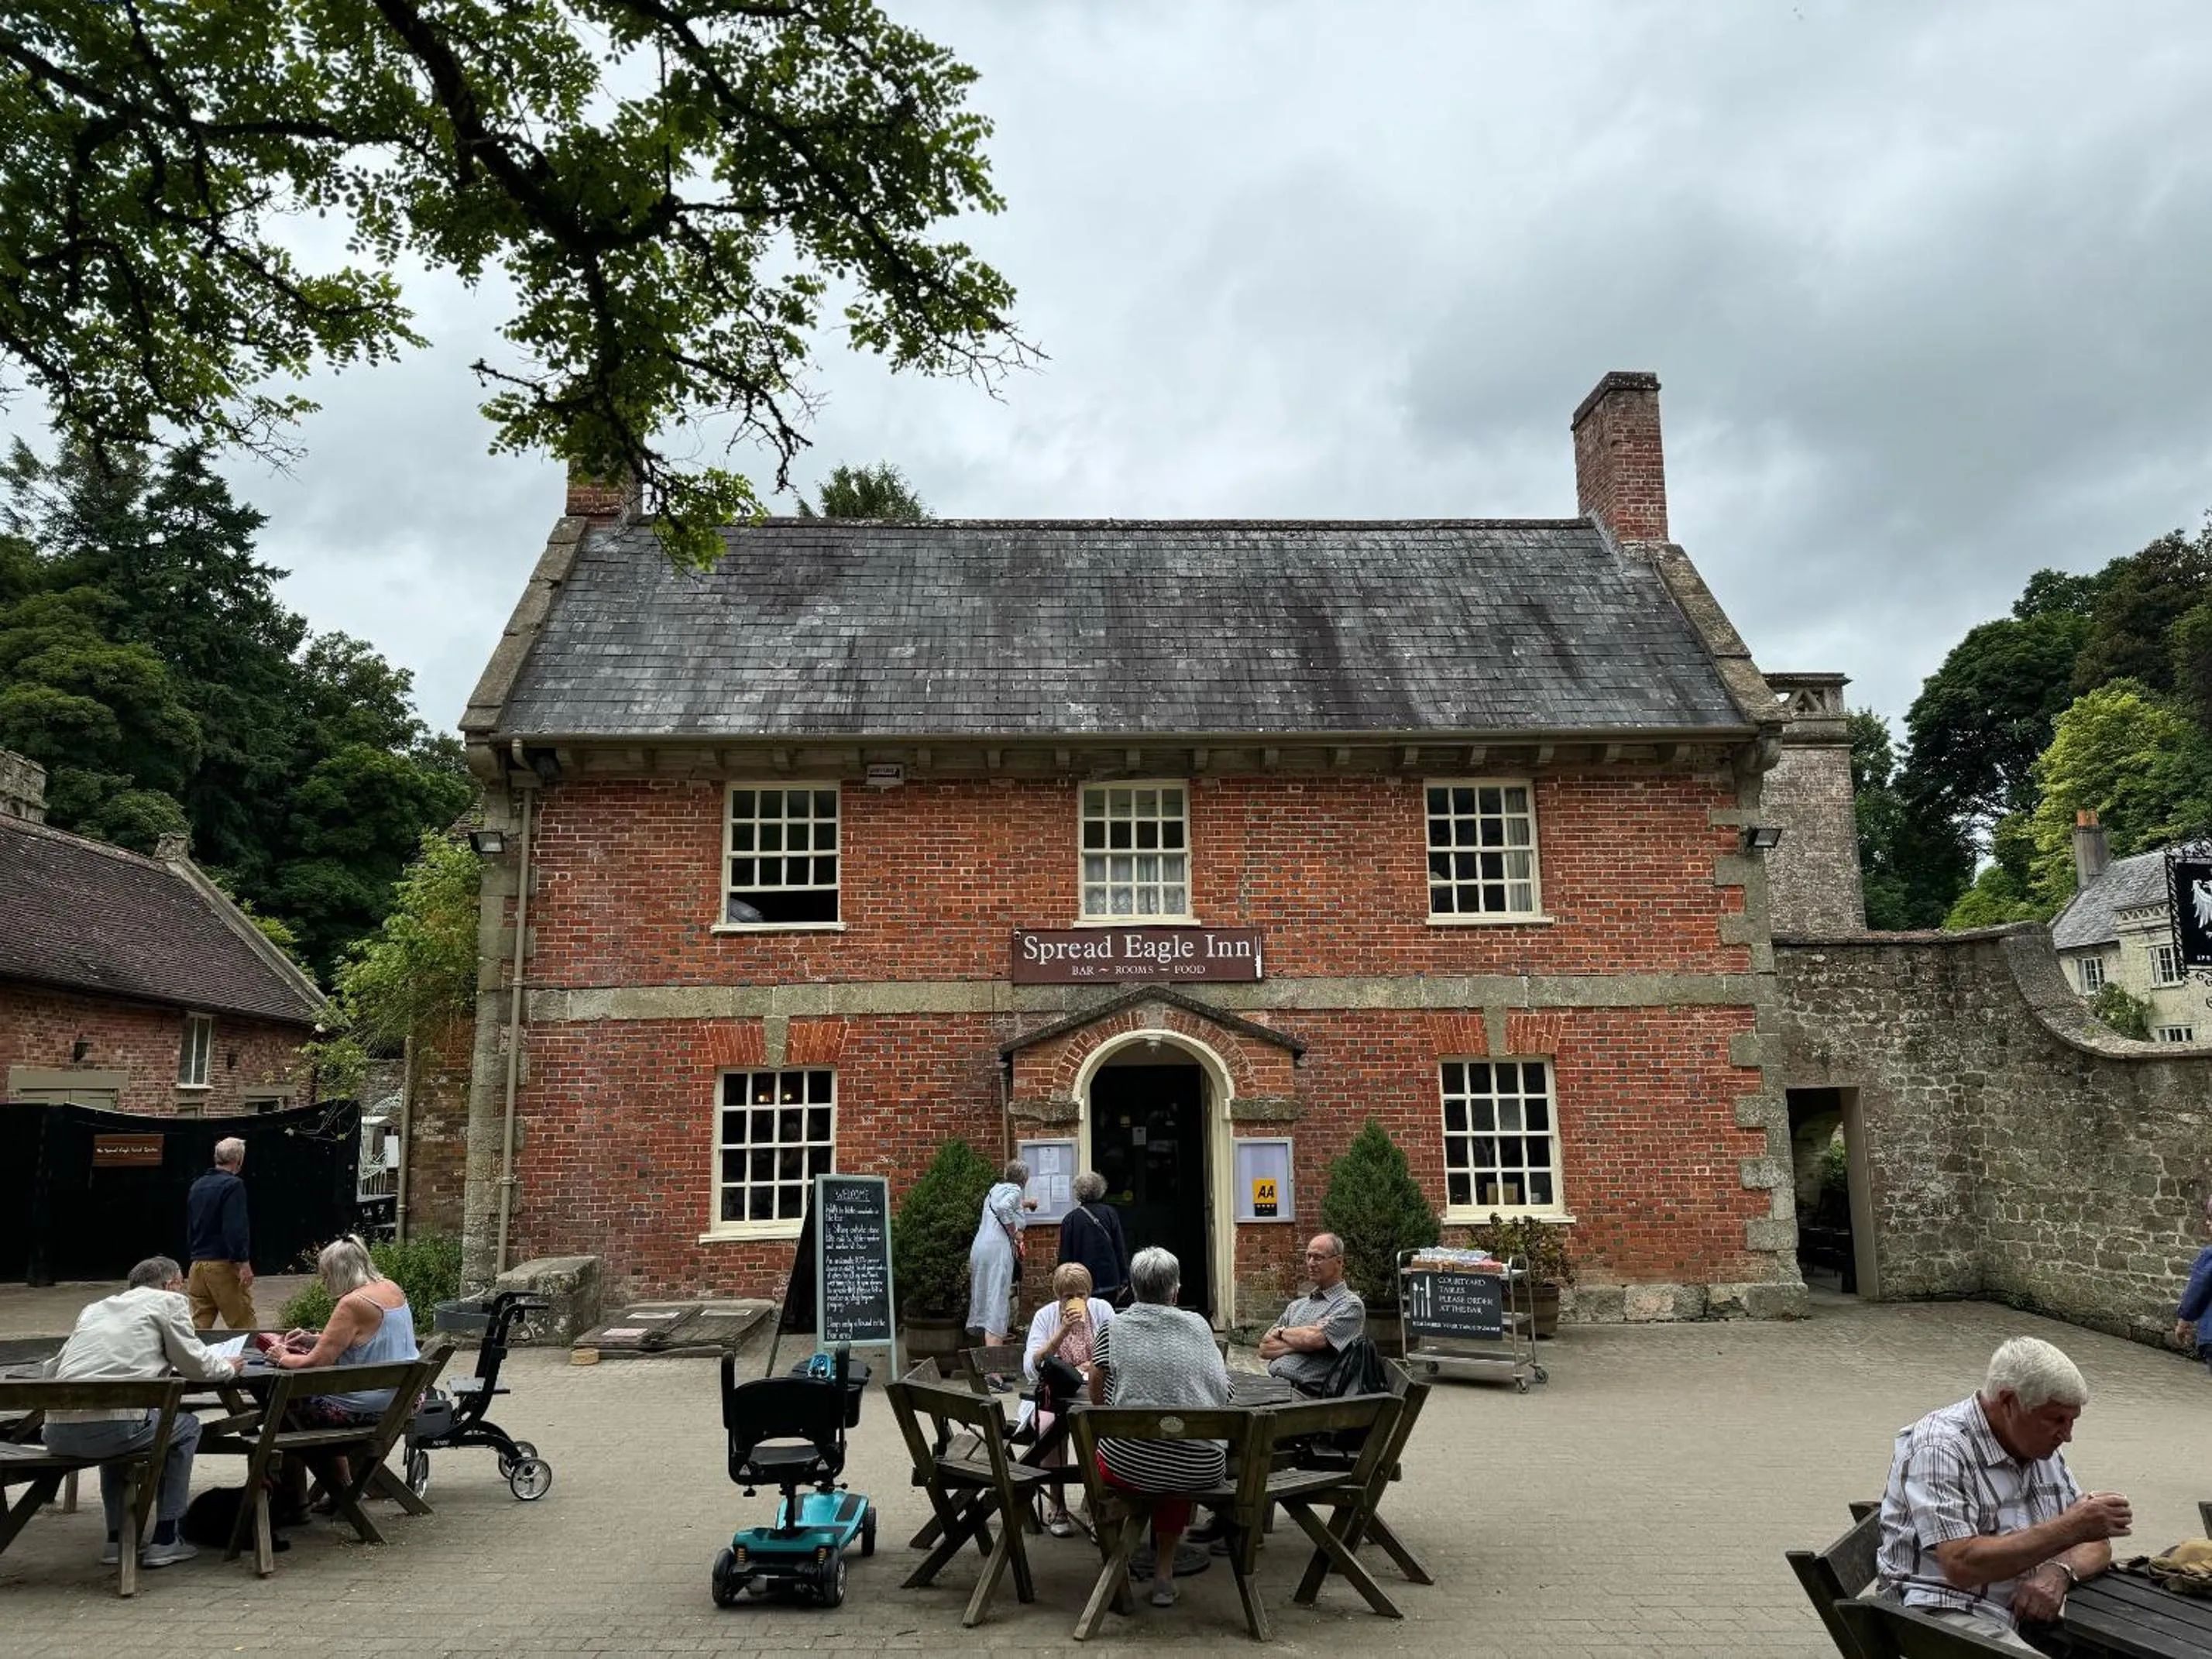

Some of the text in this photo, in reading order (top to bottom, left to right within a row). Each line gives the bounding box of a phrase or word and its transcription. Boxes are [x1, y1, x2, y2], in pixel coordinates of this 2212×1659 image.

[1023, 934, 1252, 964] Spread Eagle Inn
[1071, 966, 1094, 976] BAR
[1115, 965, 1154, 975] ROOMS
[1174, 965, 1206, 974] FOOD
[1257, 1185, 1274, 1199] AA
